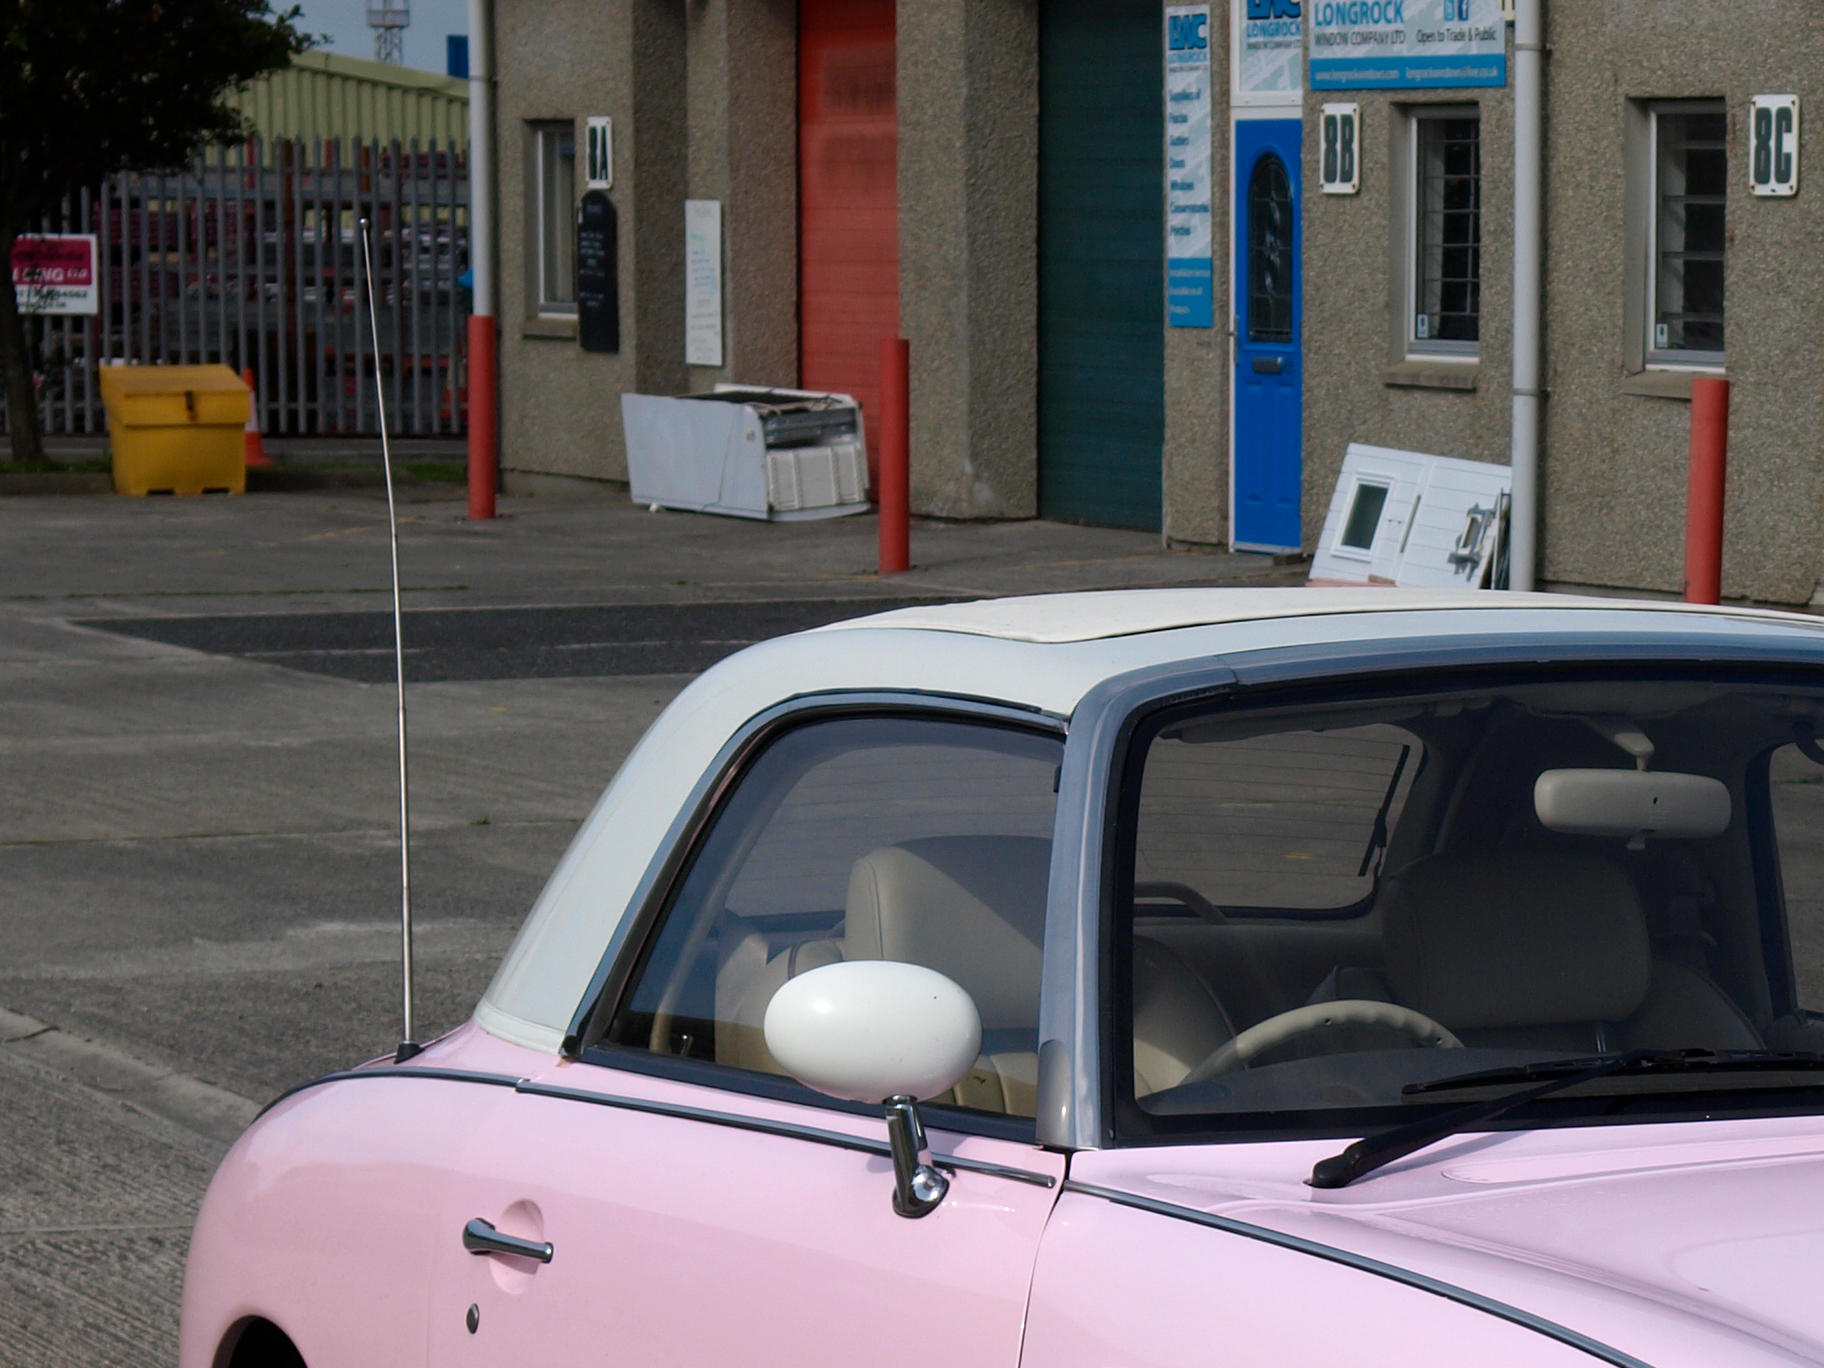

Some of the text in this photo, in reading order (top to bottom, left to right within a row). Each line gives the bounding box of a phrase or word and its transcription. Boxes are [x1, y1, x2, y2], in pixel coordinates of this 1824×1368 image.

[1314, 0, 1404, 26] LONGROCK
[1314, 31, 1349, 46] WINDOW
[1350, 30, 1389, 45] COMPANY
[1391, 29, 1405, 44] LTD
[1416, 28, 1436, 46] Open
[1437, 31, 1445, 42] to
[1446, 27, 1466, 42] Trade
[1474, 26, 1497, 41] Public
[1324, 114, 1355, 183] 8B
[1754, 106, 1792, 184] 8C
